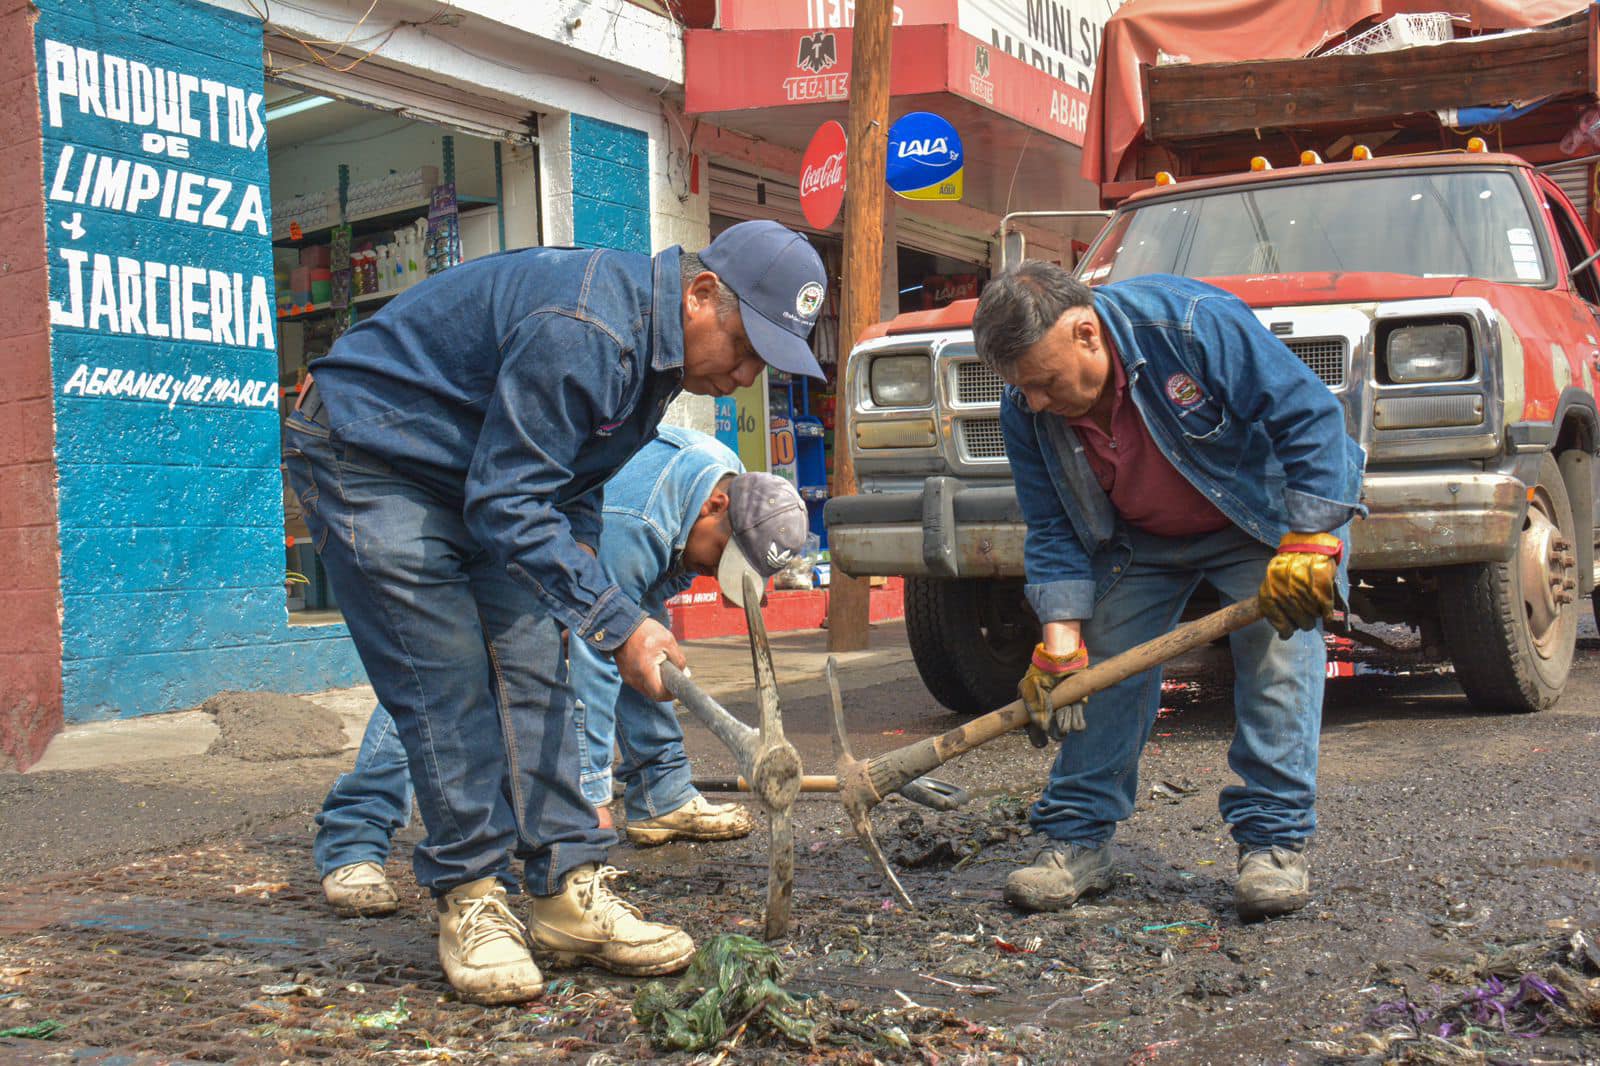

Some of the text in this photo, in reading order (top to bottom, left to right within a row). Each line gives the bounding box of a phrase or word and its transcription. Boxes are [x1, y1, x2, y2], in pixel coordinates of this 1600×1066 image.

[1027, 0, 1072, 58] MINI
[45, 38, 265, 152] PRODUCTOS
[783, 73, 848, 100] TECATE
[1050, 89, 1087, 133] ABAR
[142, 133, 190, 159] DE
[898, 137, 948, 158] LALA
[49, 145, 268, 235] LIMPIEZA
[49, 247, 275, 350] JARCIERIA
[203, 378, 278, 408] MARCA
